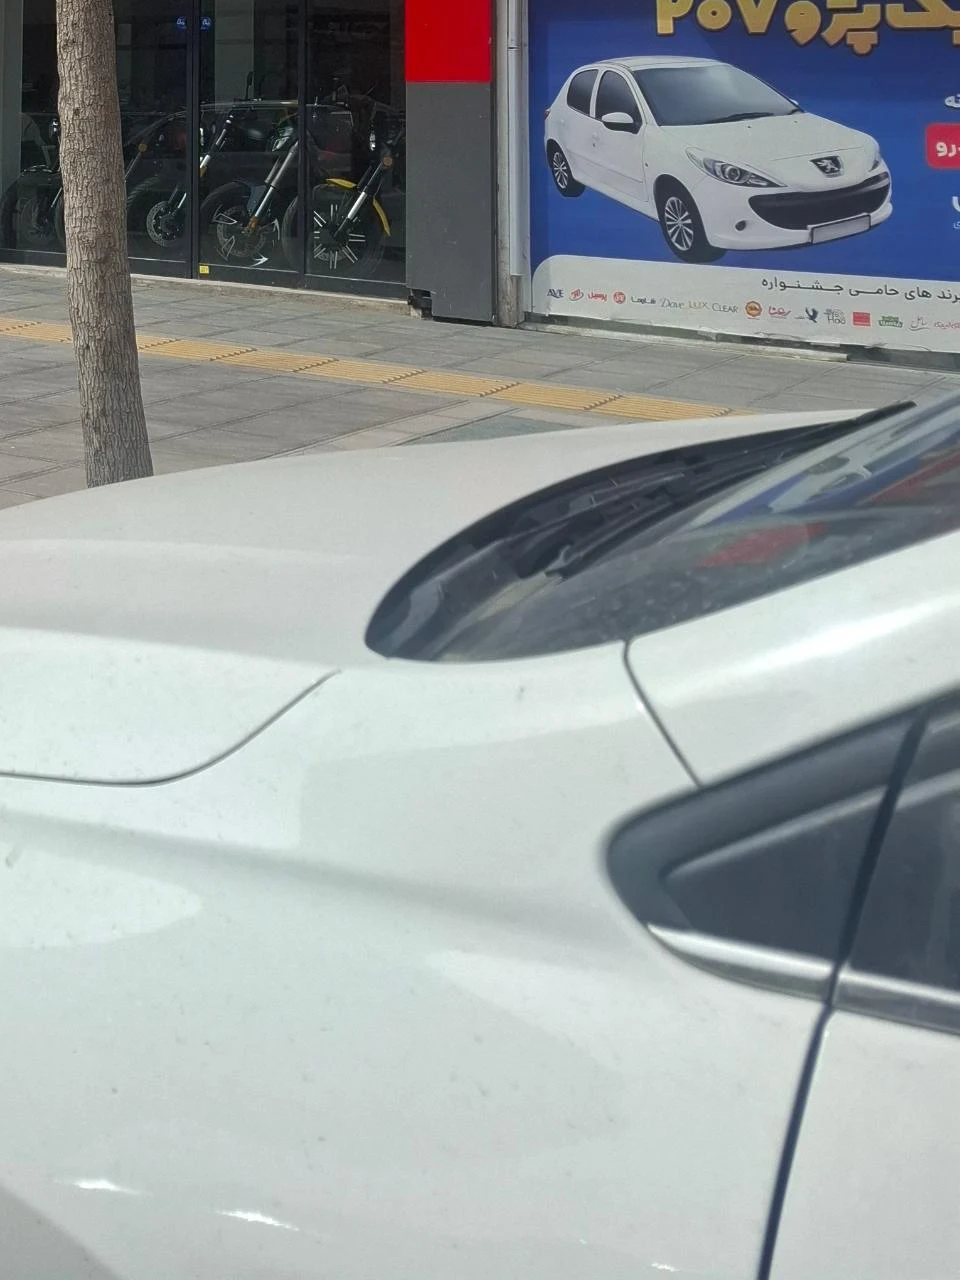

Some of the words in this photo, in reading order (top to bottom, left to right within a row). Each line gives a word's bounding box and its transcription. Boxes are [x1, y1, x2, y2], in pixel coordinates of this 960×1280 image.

[761, 276, 844, 295] جشنواره
[848, 283, 900, 297] حامی
[904, 286, 933, 300] های
[937, 289, 960, 304] رند
[711, 303, 739, 313] CLEAR
